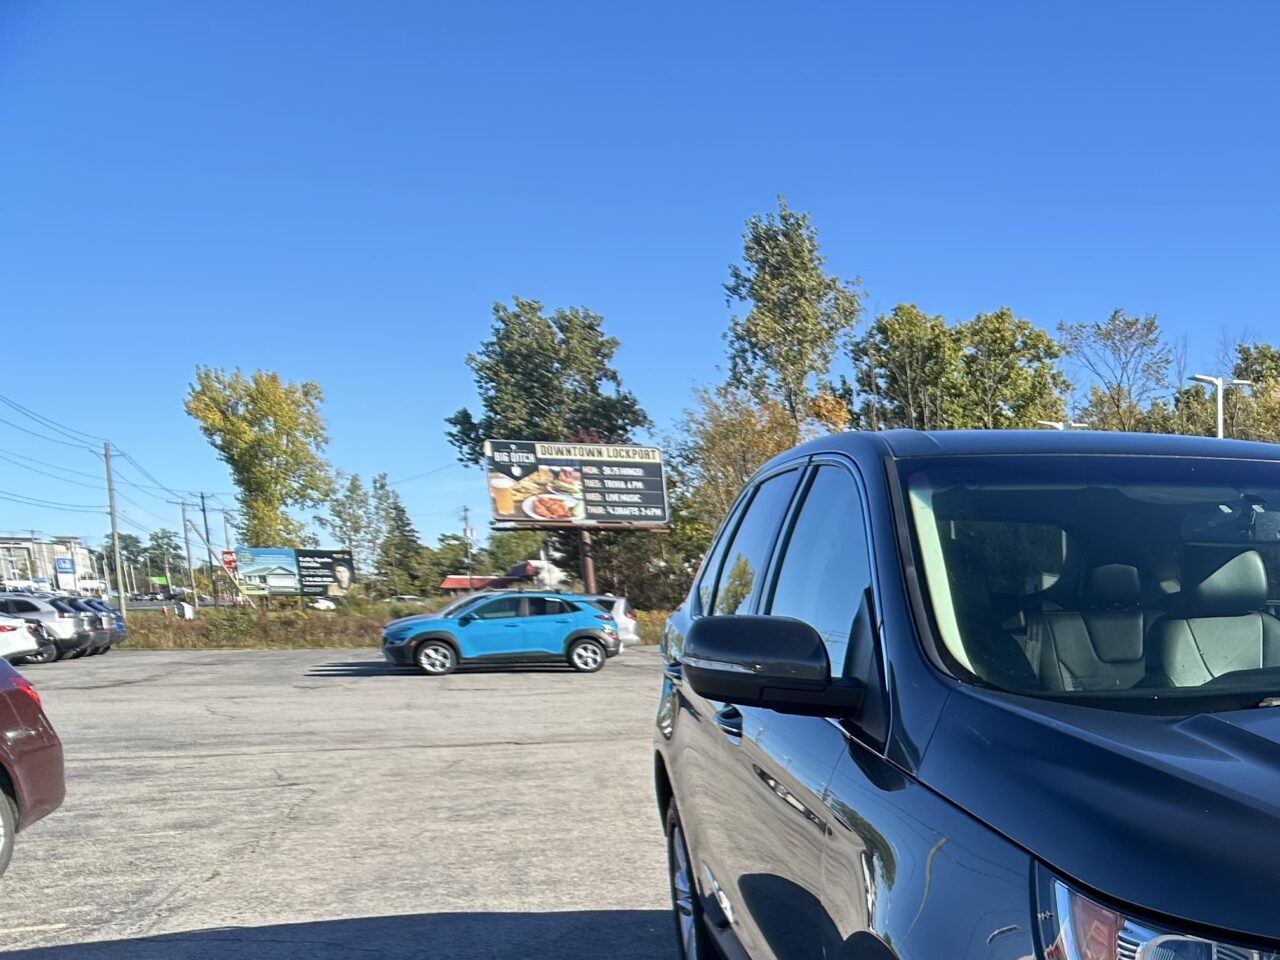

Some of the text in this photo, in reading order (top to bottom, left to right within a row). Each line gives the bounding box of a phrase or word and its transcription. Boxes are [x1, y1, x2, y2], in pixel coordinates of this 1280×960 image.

[494, 451, 536, 463] BIG DITCH
[540, 445, 656, 460] DOWNTOWN LOCKPORT
[603, 480, 625, 488] TRIVIA
[605, 493, 620, 501] LIVE
[620, 493, 642, 502] MUSIC
